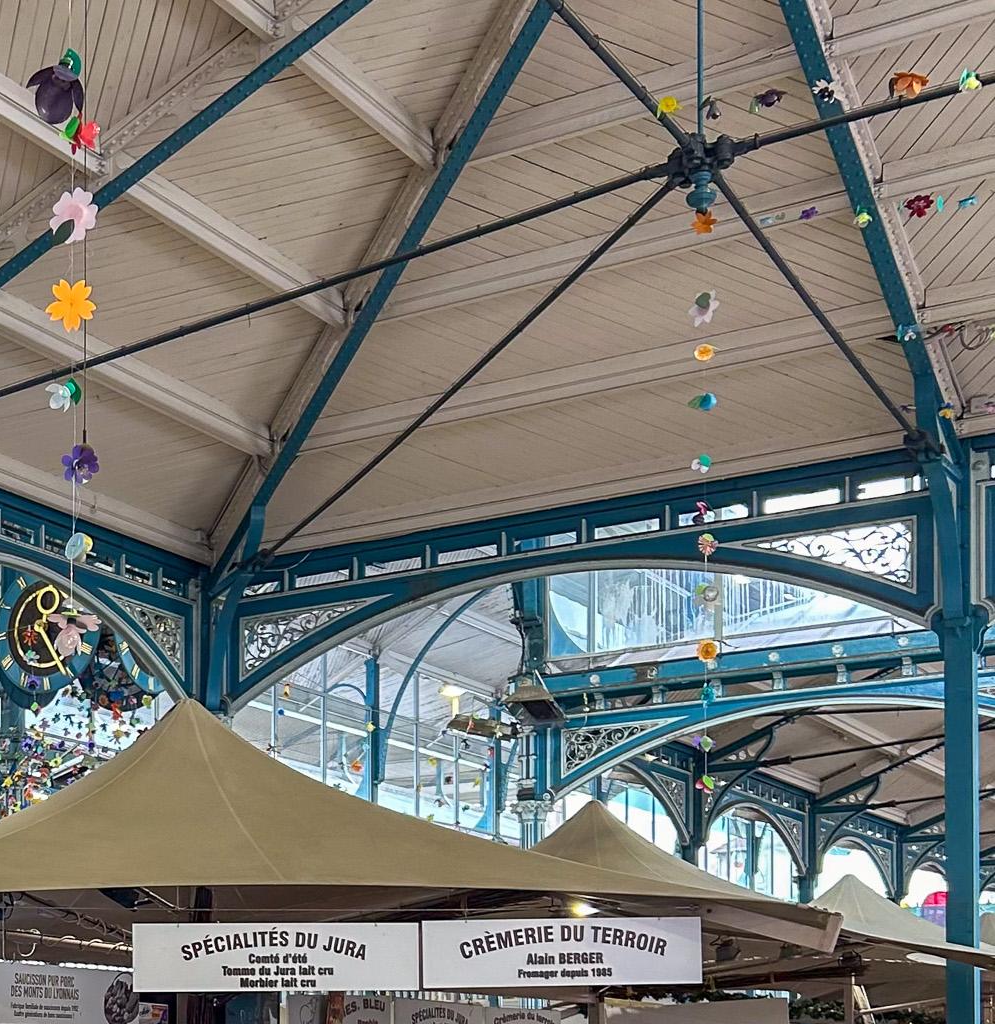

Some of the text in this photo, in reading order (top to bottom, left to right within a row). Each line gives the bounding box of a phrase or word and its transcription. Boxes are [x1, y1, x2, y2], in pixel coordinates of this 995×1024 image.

[181, 927, 366, 961] SPÉCIALITÉS DU JURA
[459, 925, 667, 959] CRÈMERIE DU TERROIR
[248, 953, 308, 964] Comté d'été
[526, 952, 604, 965] Alain BERGER
[222, 965, 334, 977] Tomme du Jura lait cru
[517, 968, 613, 979] Fromager depuis 1985
[240, 977, 316, 988] Morbier lait cru
[11, 985, 22, 997] DES
[363, 999, 386, 1012] BLEU
